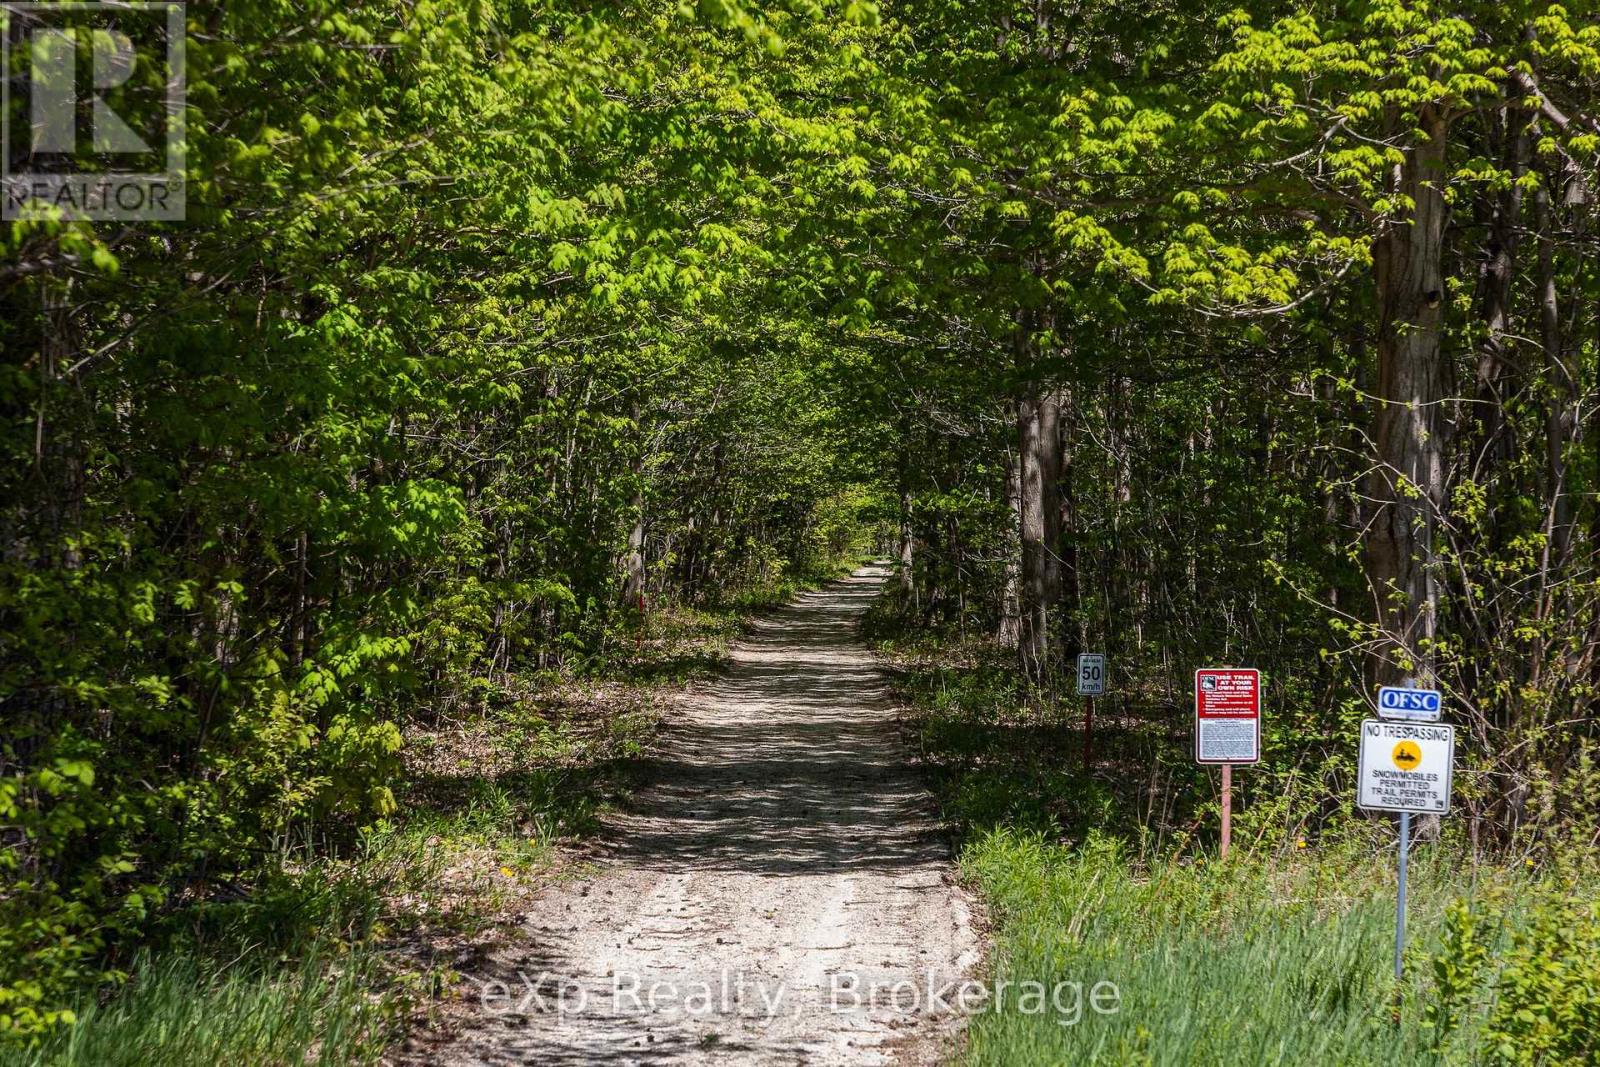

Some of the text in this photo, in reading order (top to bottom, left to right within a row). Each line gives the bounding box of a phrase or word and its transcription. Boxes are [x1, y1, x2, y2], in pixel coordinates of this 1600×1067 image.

[1082, 666, 1100, 680] 50
[1383, 691, 1437, 710] OFSC
[1367, 725, 1448, 741] NO TRESPASSING
[1372, 769, 1439, 782] SNOWMOBILES
[1380, 780, 1430, 790] PERMITTED
[1371, 787, 1438, 799] TRAIL PERMITS
[1381, 796, 1427, 807] REQUIRED
